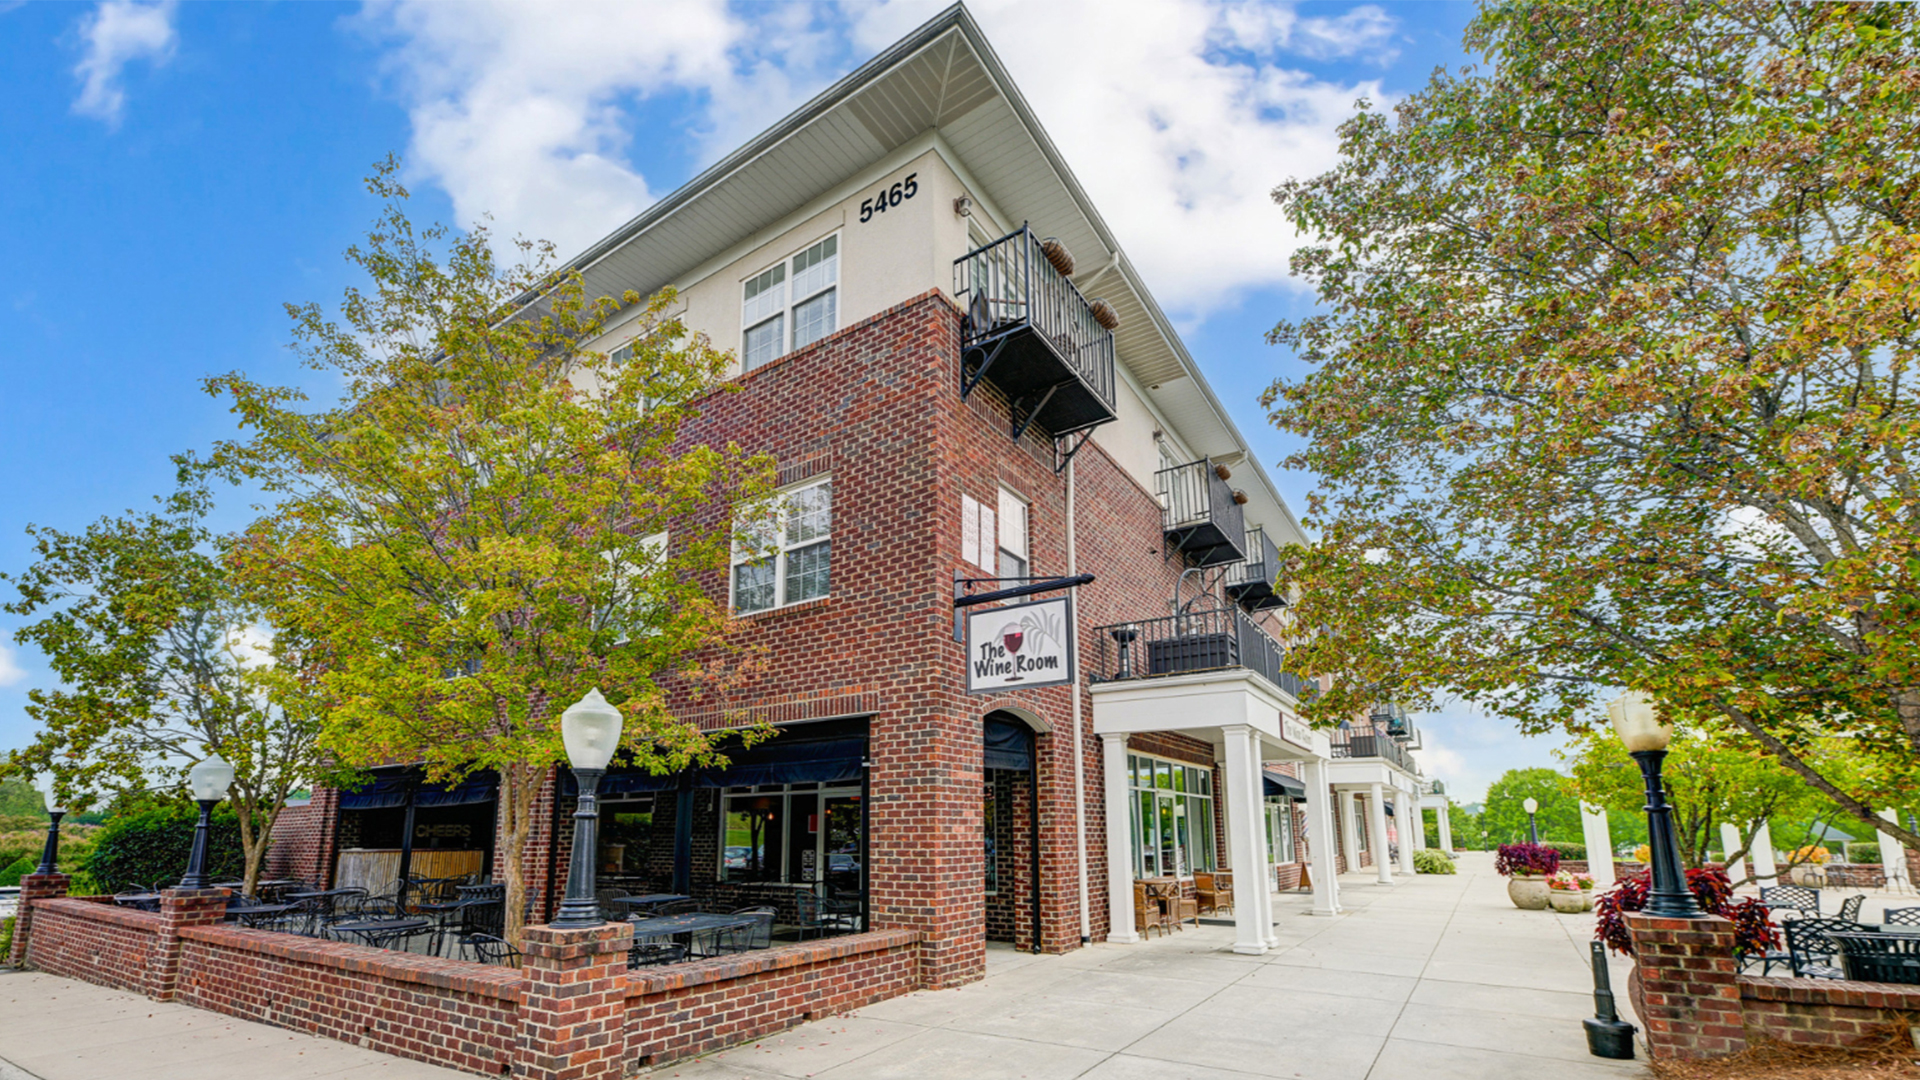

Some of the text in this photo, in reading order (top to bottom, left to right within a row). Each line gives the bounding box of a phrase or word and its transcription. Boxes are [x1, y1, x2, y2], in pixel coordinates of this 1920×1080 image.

[859, 172, 918, 223] 5465
[980, 642, 1005, 660] The
[974, 654, 1058, 678] Wine Room
[415, 824, 471, 837] CHEERS
